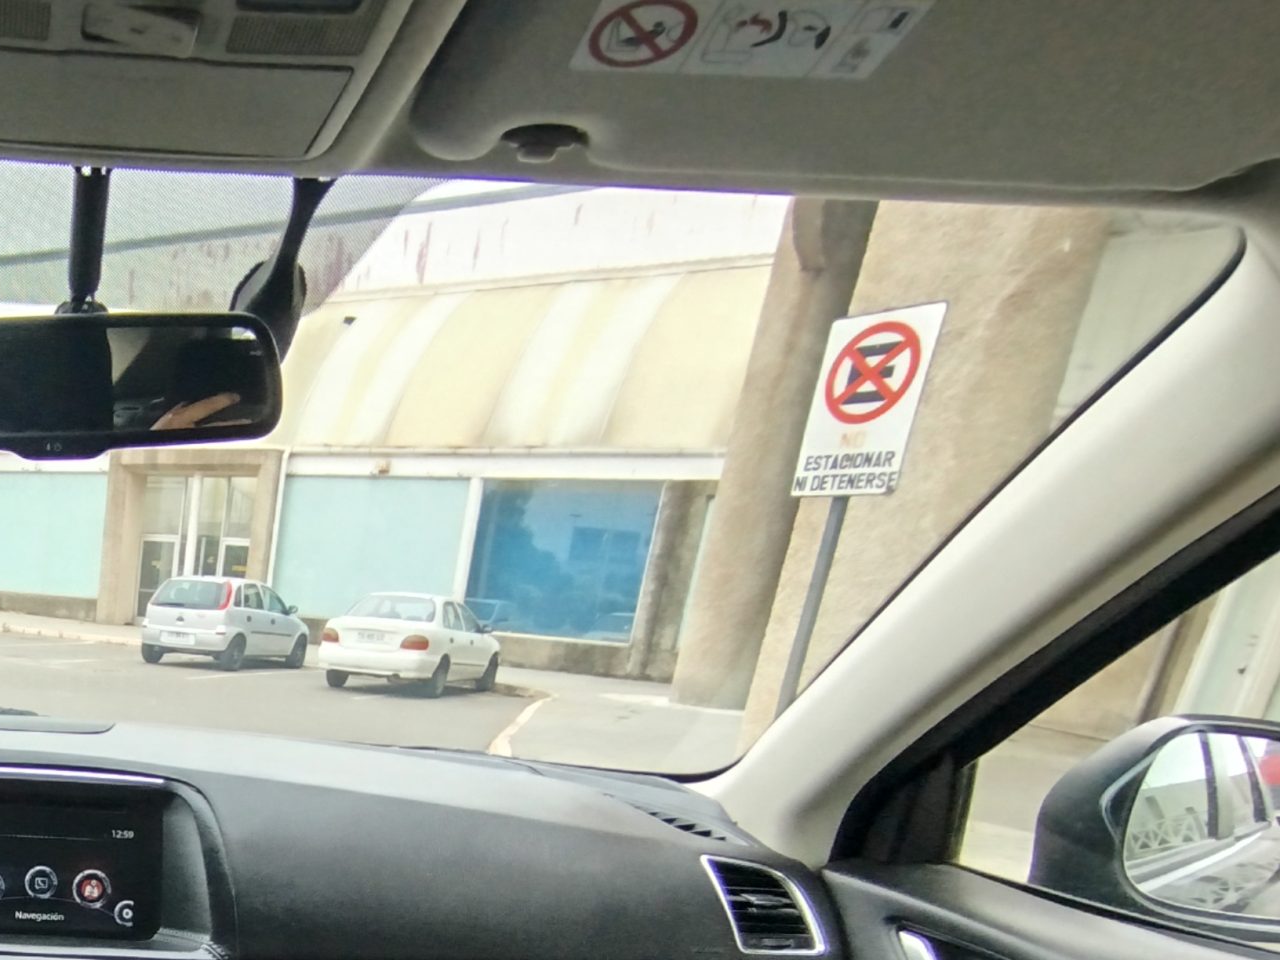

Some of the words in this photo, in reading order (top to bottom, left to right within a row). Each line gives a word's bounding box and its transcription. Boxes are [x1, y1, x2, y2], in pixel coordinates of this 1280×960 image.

[803, 451, 896, 472] ESTACIONAR
[793, 476, 808, 492] NI
[809, 471, 898, 492] DETENERSE
[14, 910, 65, 922] Navegación
